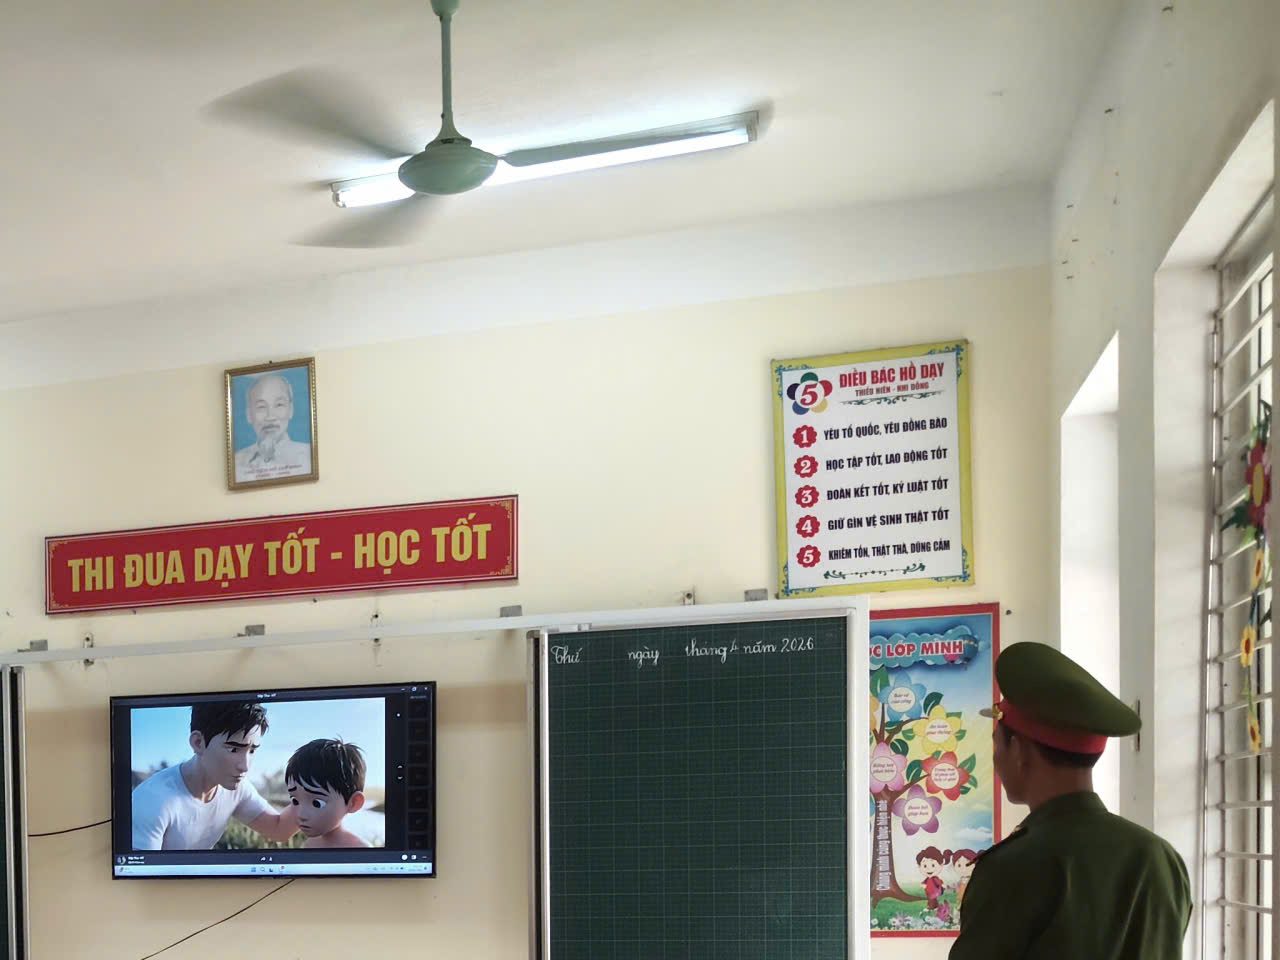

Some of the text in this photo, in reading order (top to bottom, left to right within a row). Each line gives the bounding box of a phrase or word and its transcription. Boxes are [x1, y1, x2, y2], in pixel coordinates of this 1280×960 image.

[840, 361, 945, 388] ĐIỀU BÁC HỒ DẠY
[801, 383, 818, 406] 5
[801, 430, 809, 443] 1
[824, 427, 839, 440] YÊU
[884, 422, 900, 434] YÊU
[903, 417, 927, 432] ĐỒNG
[930, 416, 948, 429] BÀO
[800, 459, 811, 474] 2
[826, 459, 845, 472] HỌC
[847, 455, 863, 470] TẬP
[886, 453, 901, 465] LAO
[904, 450, 928, 464] ĐỘNG
[931, 445, 948, 460] TỐT
[801, 490, 813, 504] 3
[827, 486, 851, 500] ĐOÀN
[854, 483, 870, 498] KẾT
[907, 480, 929, 494] LUẬT
[931, 475, 949, 490] TỐT
[802, 506, 950, 533] 4 GIỮ GÌN VỆ SINH THẬT TỐT
[67, 512, 491, 593] THI ĐUA DẠY TỐT - HỌC TỐT
[803, 550, 814, 563] 5
[627, 645, 660, 669] ngày
[743, 640, 777, 654] năm
[781, 637, 814, 653] 2026
[887, 640, 916, 657] LỚP
[921, 638, 963, 655] MÌNH
